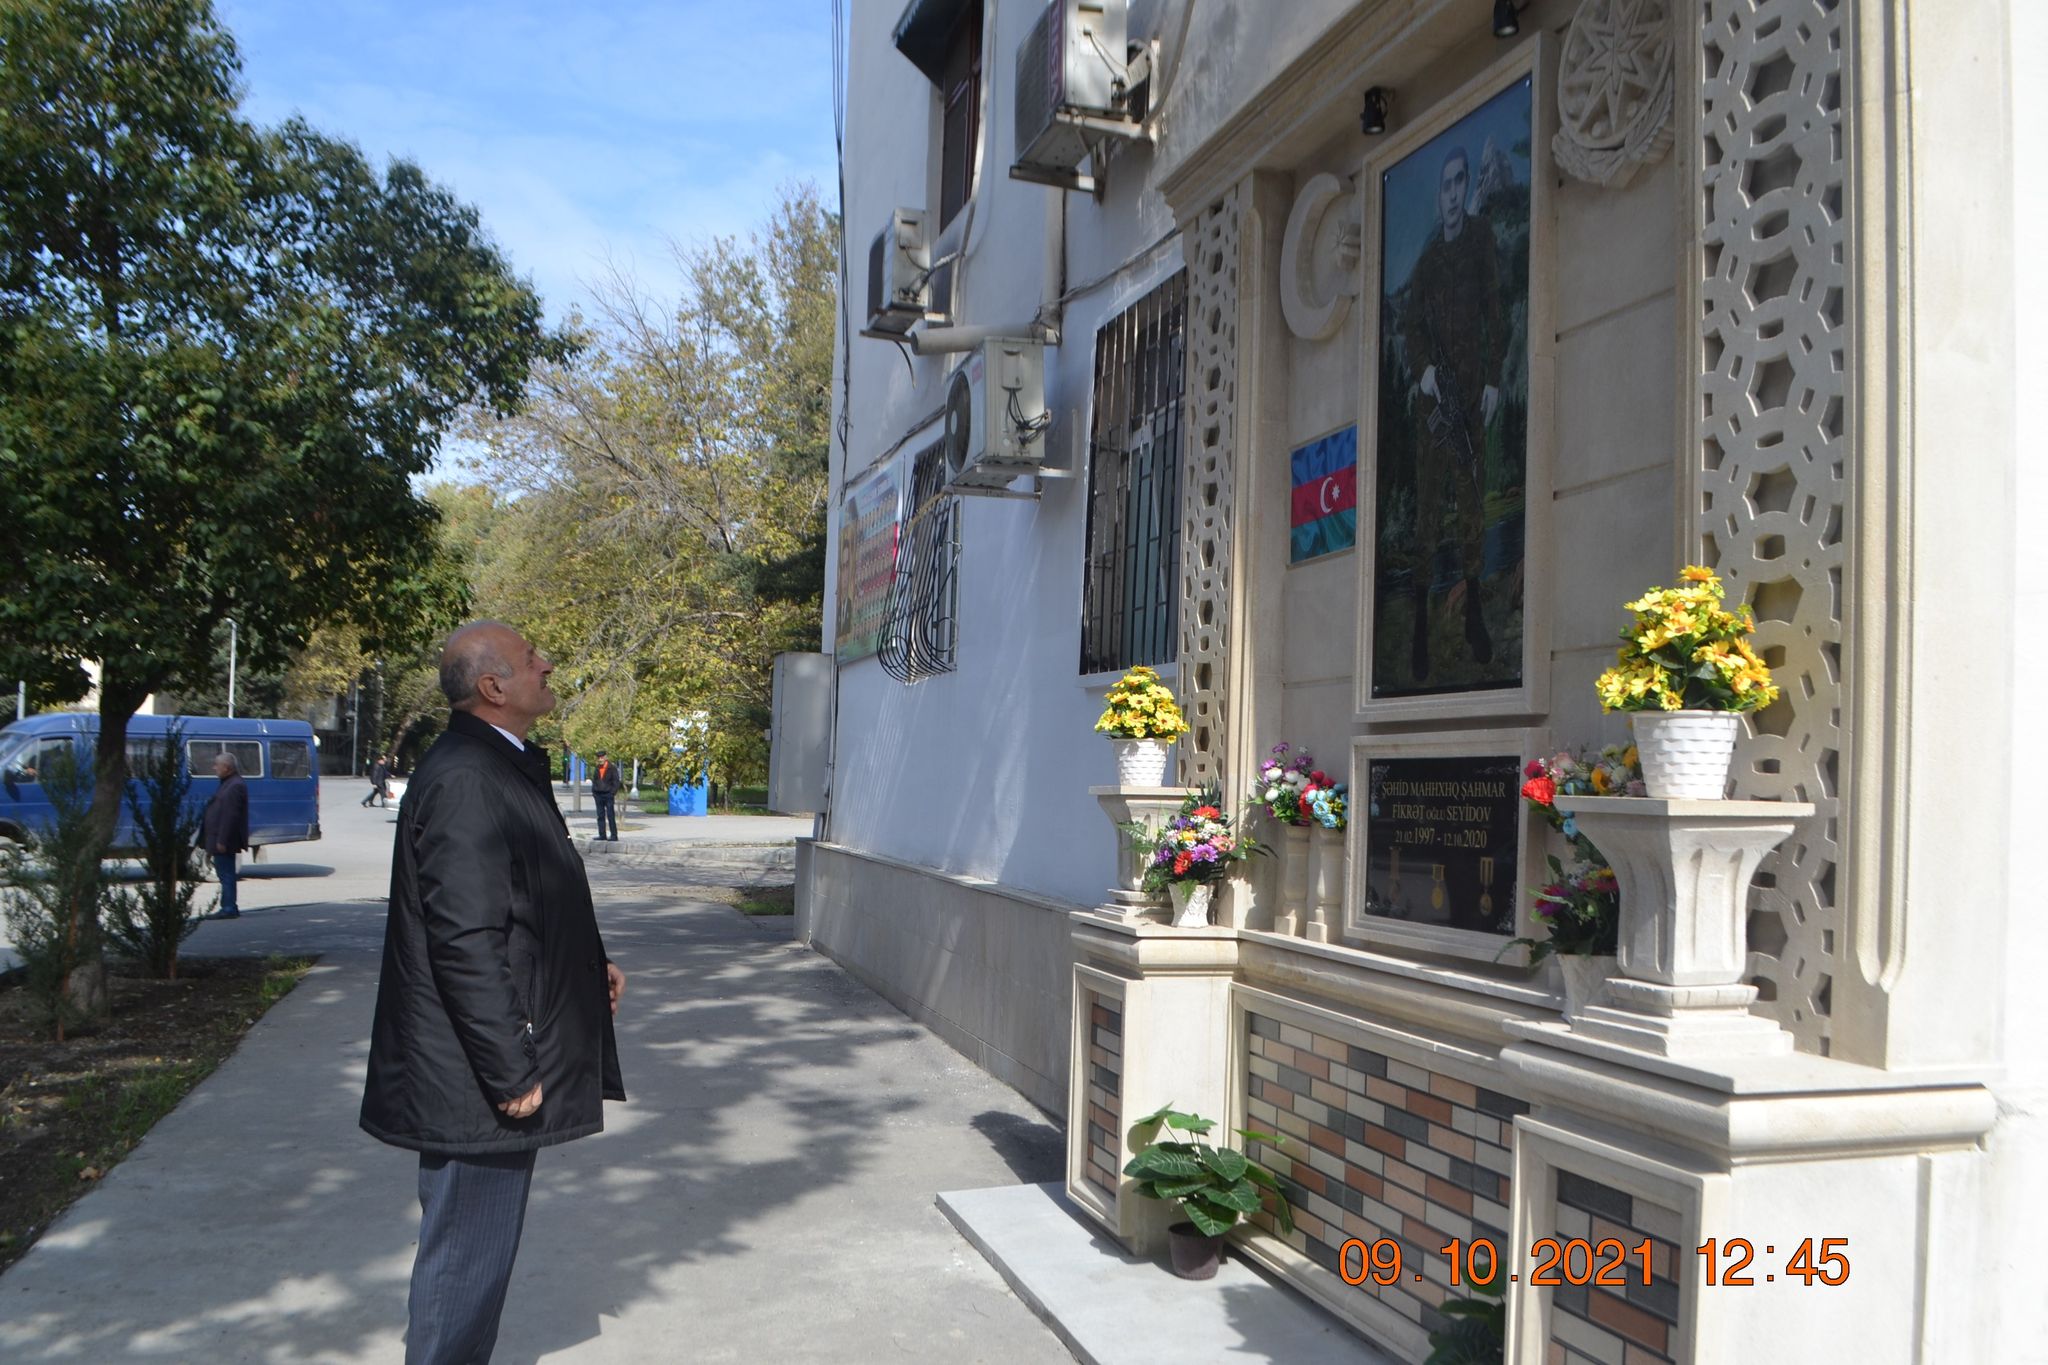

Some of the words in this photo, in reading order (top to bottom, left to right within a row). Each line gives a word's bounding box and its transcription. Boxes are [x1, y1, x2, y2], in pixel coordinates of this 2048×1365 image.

[1381, 779, 1408, 799] ŞƏHİD
[1461, 781, 1506, 800] ŞAHMAR
[1446, 803, 1491, 822] SEYİDOV
